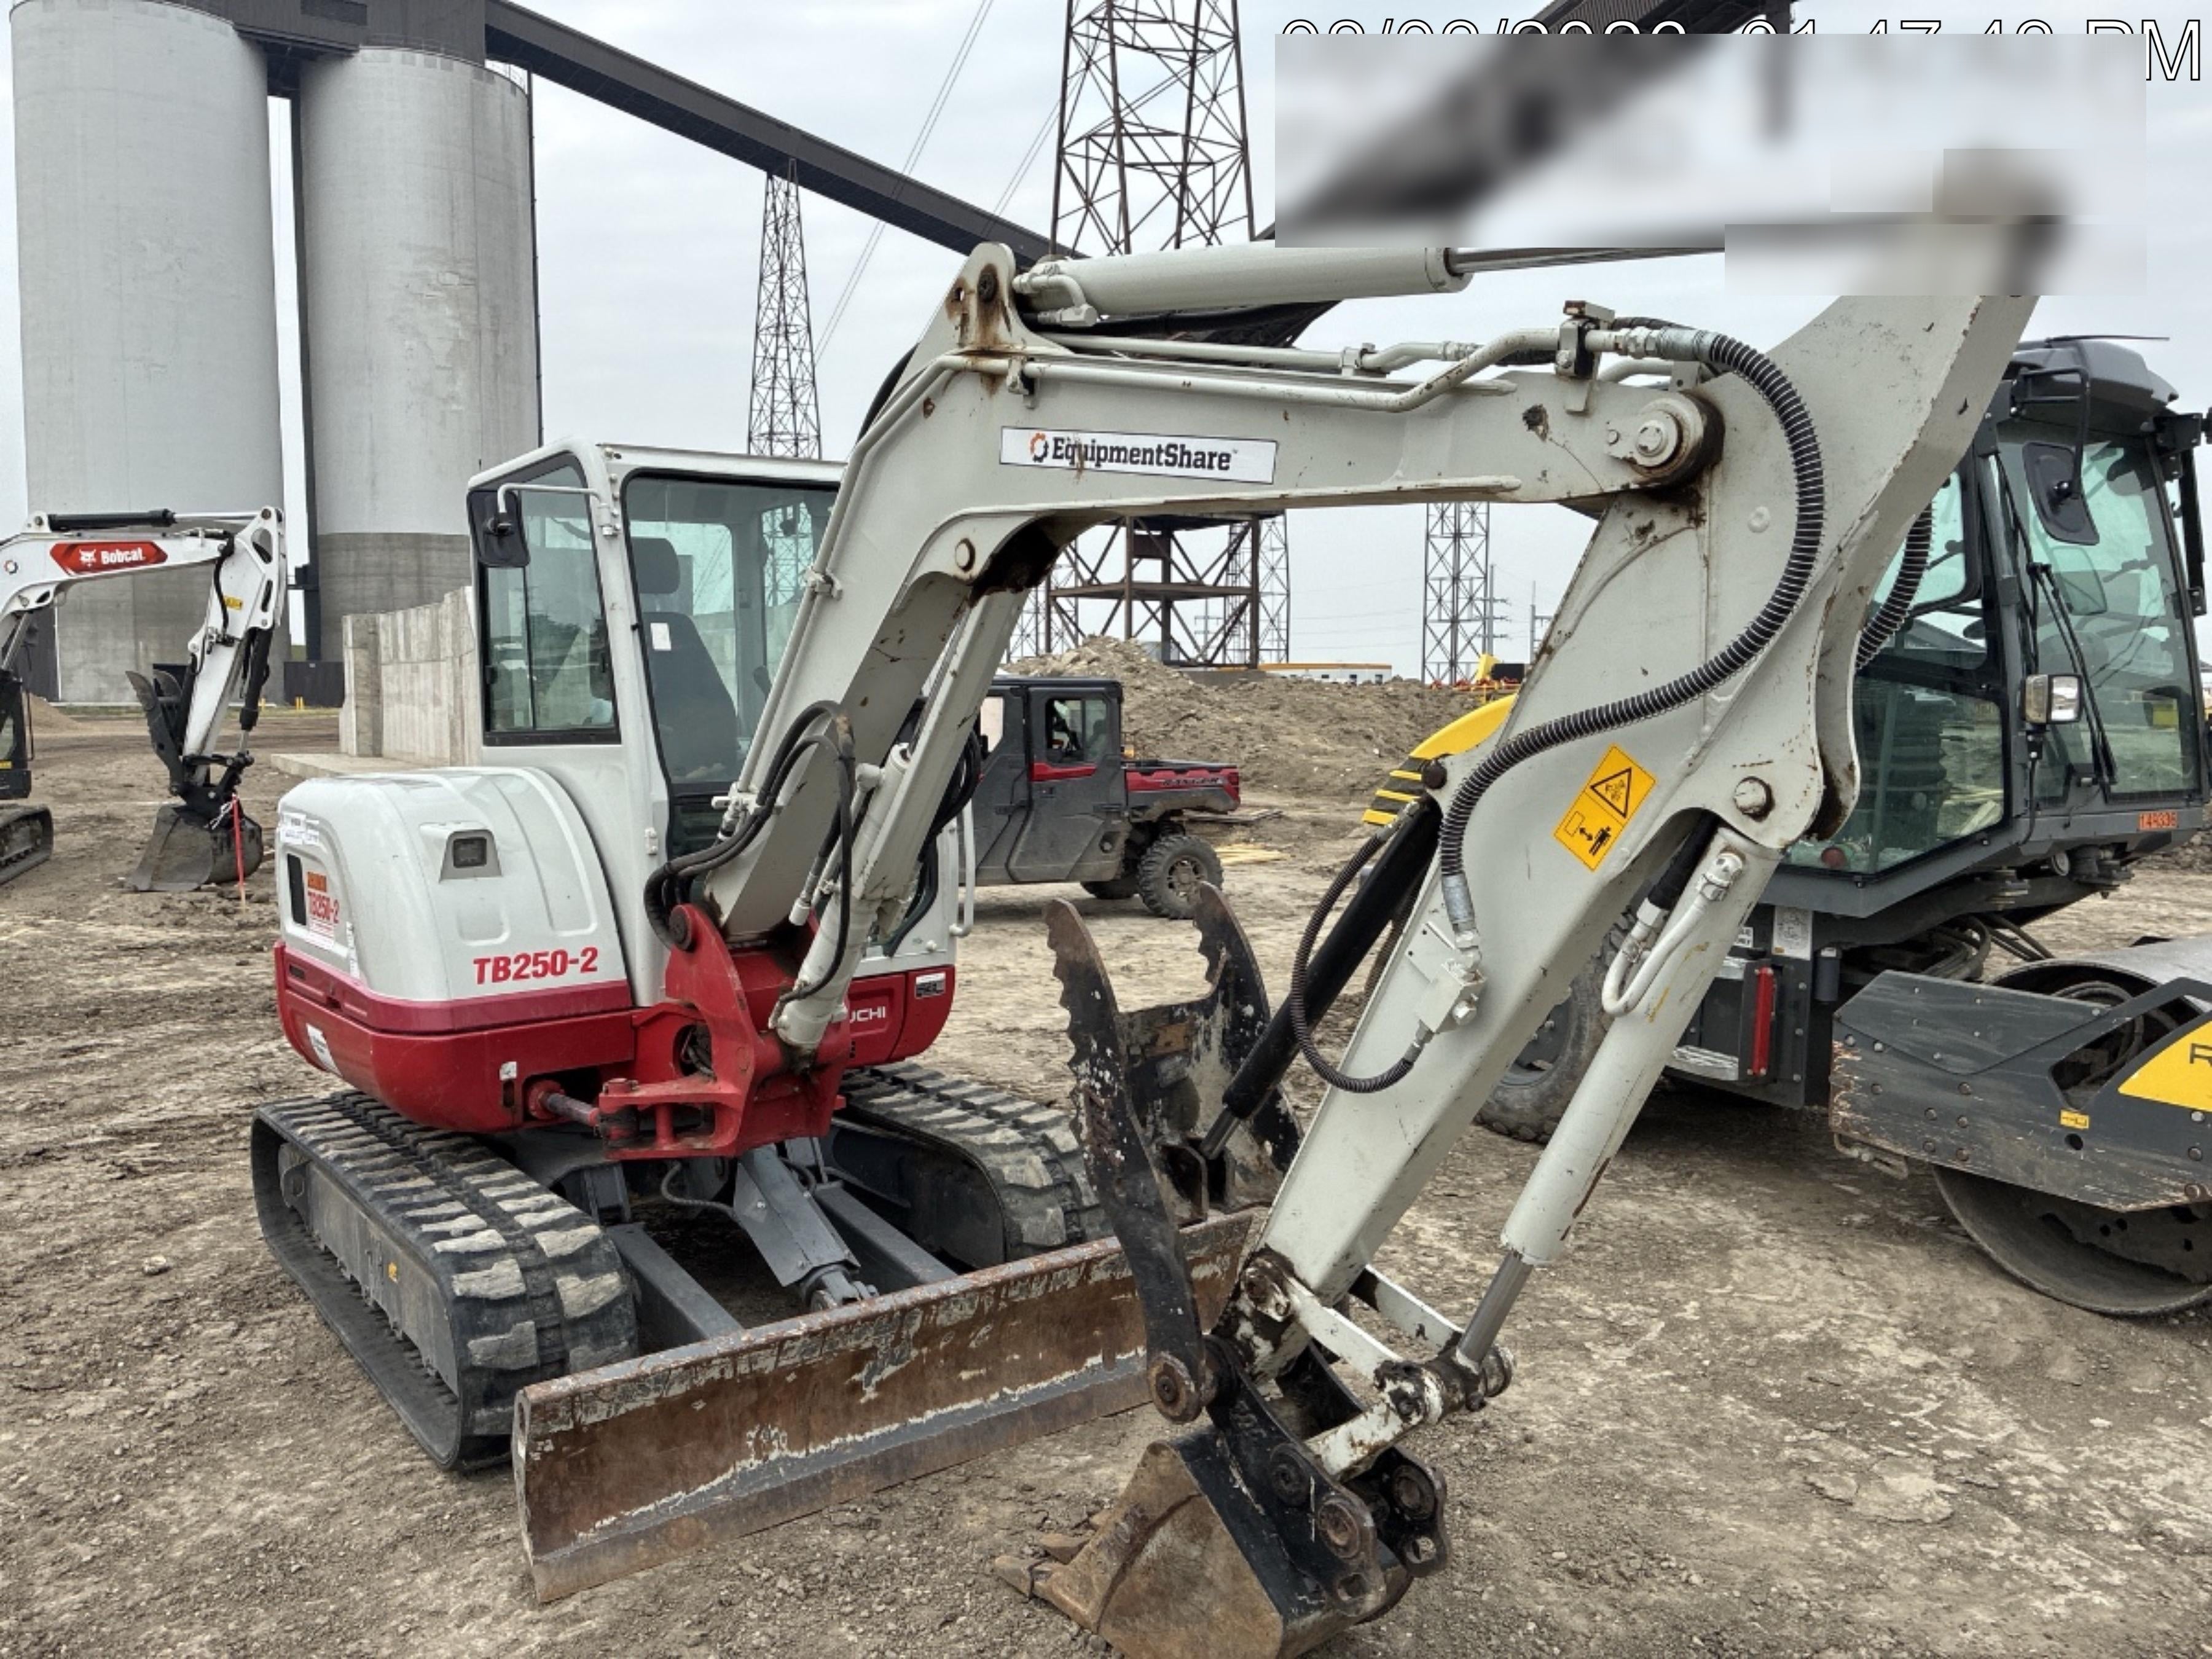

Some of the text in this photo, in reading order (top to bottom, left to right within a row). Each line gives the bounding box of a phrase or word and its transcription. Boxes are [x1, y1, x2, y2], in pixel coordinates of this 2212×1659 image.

[1052, 431, 1232, 471] EquipmentShare
[101, 547, 143, 565] Bobcat
[473, 946, 598, 984] TB250-2
